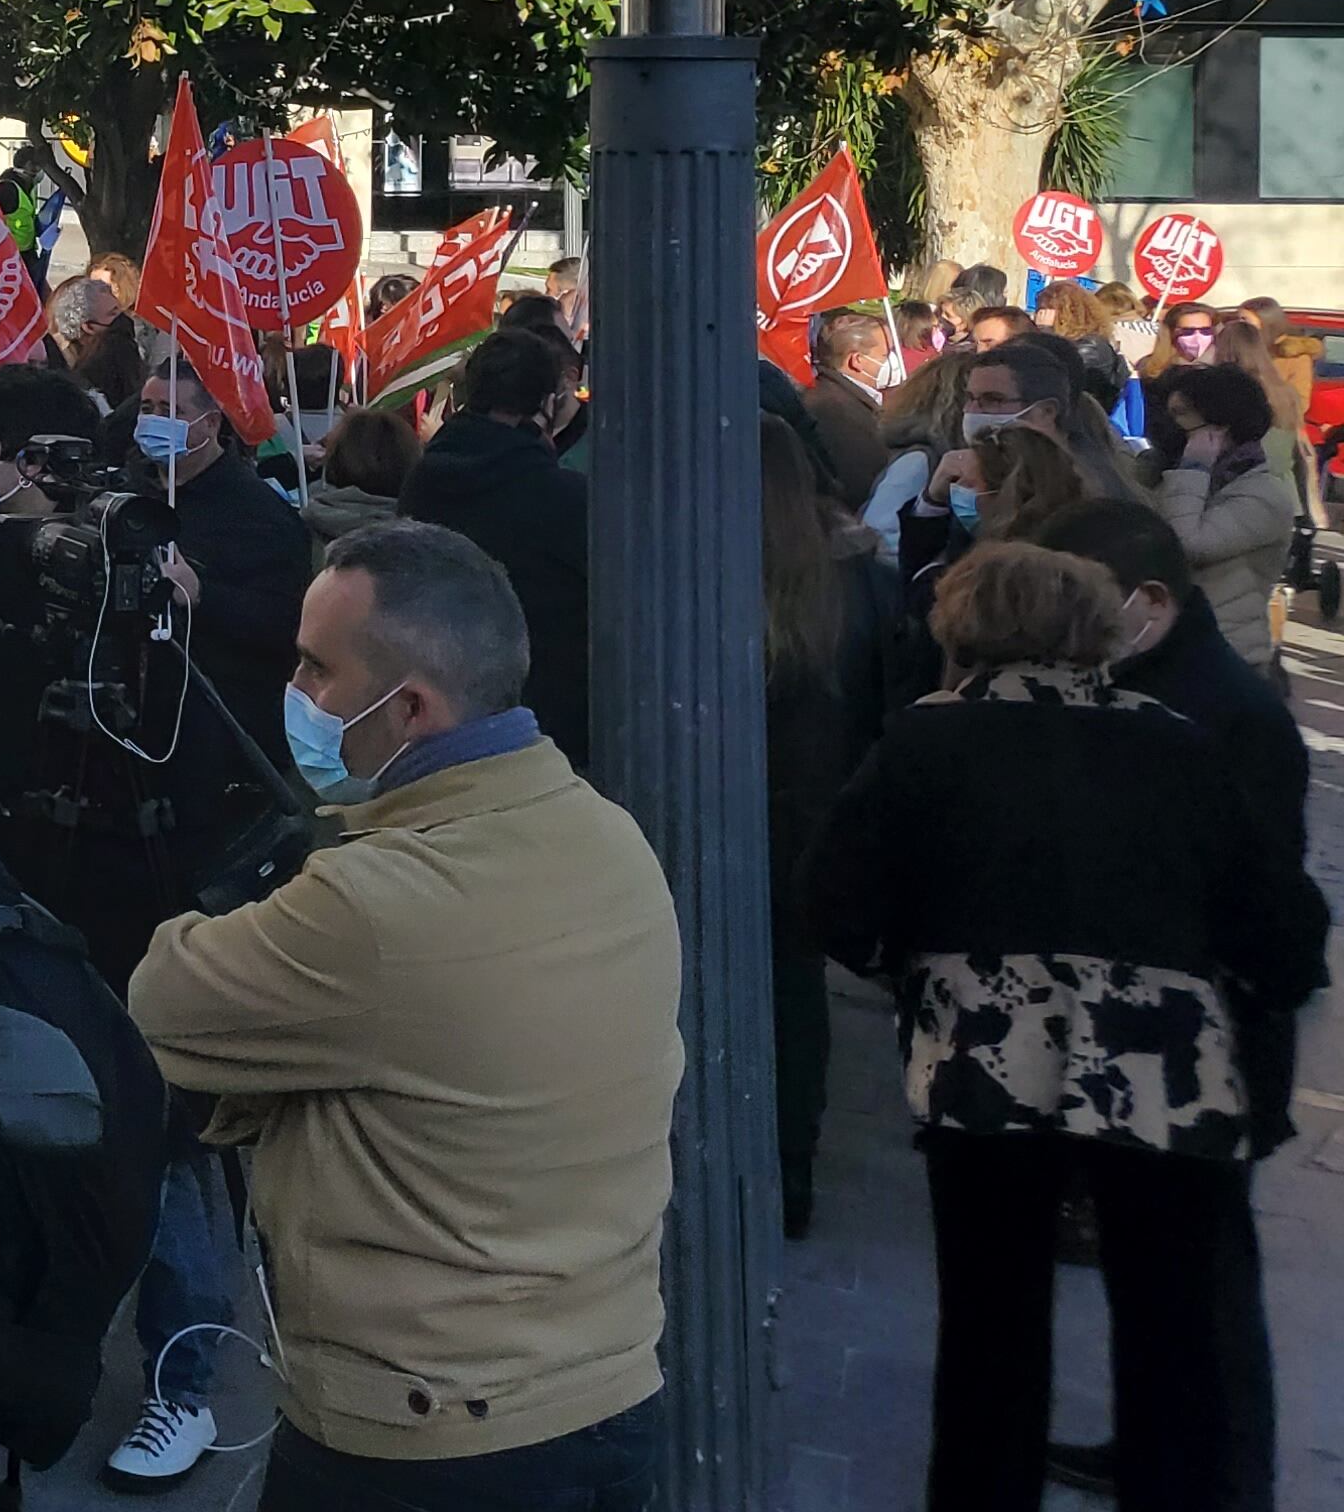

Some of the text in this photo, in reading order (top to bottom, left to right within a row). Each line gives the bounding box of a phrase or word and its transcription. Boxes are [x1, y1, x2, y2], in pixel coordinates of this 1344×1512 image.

[1026, 196, 1095, 244] UGT
[1149, 217, 1217, 268] UGT
[239, 280, 326, 309] Andaucía
